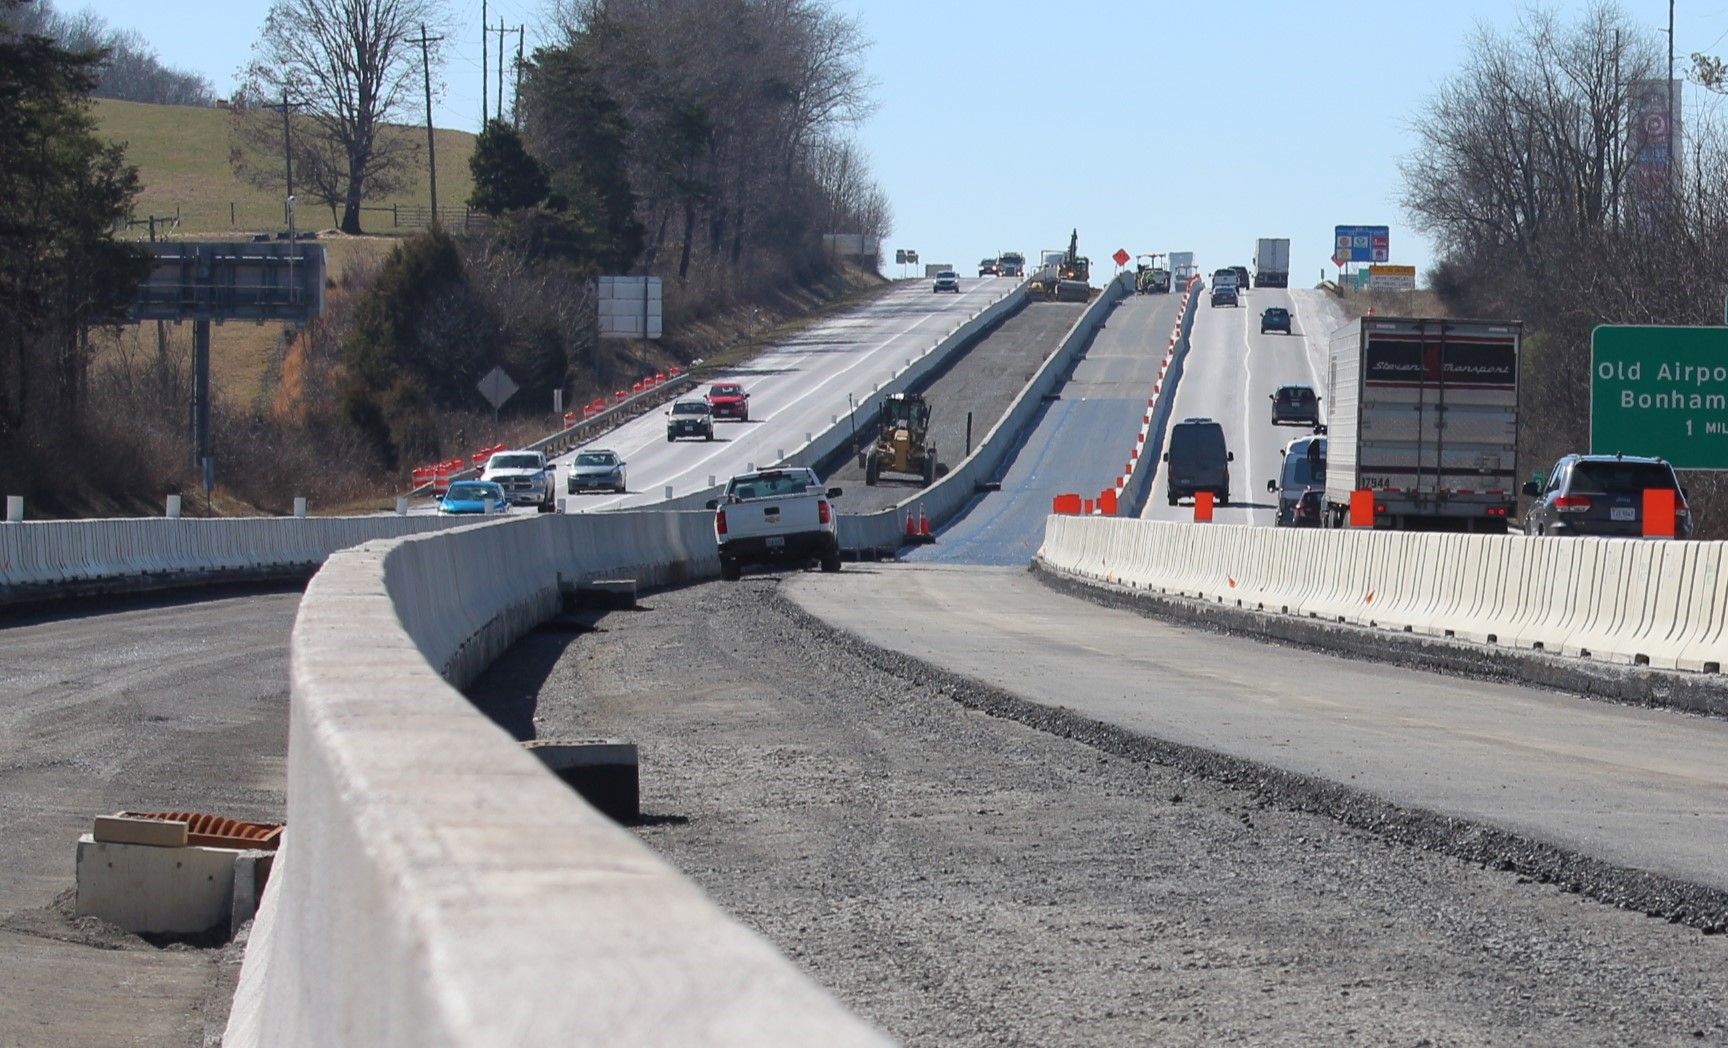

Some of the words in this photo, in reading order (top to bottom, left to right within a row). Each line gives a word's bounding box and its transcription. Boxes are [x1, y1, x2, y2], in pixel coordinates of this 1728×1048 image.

[1442, 362, 1511, 375] Transport
[1598, 361, 1641, 380] Old
[1620, 390, 1726, 410] Bonham
[1685, 419, 1693, 436] 1
